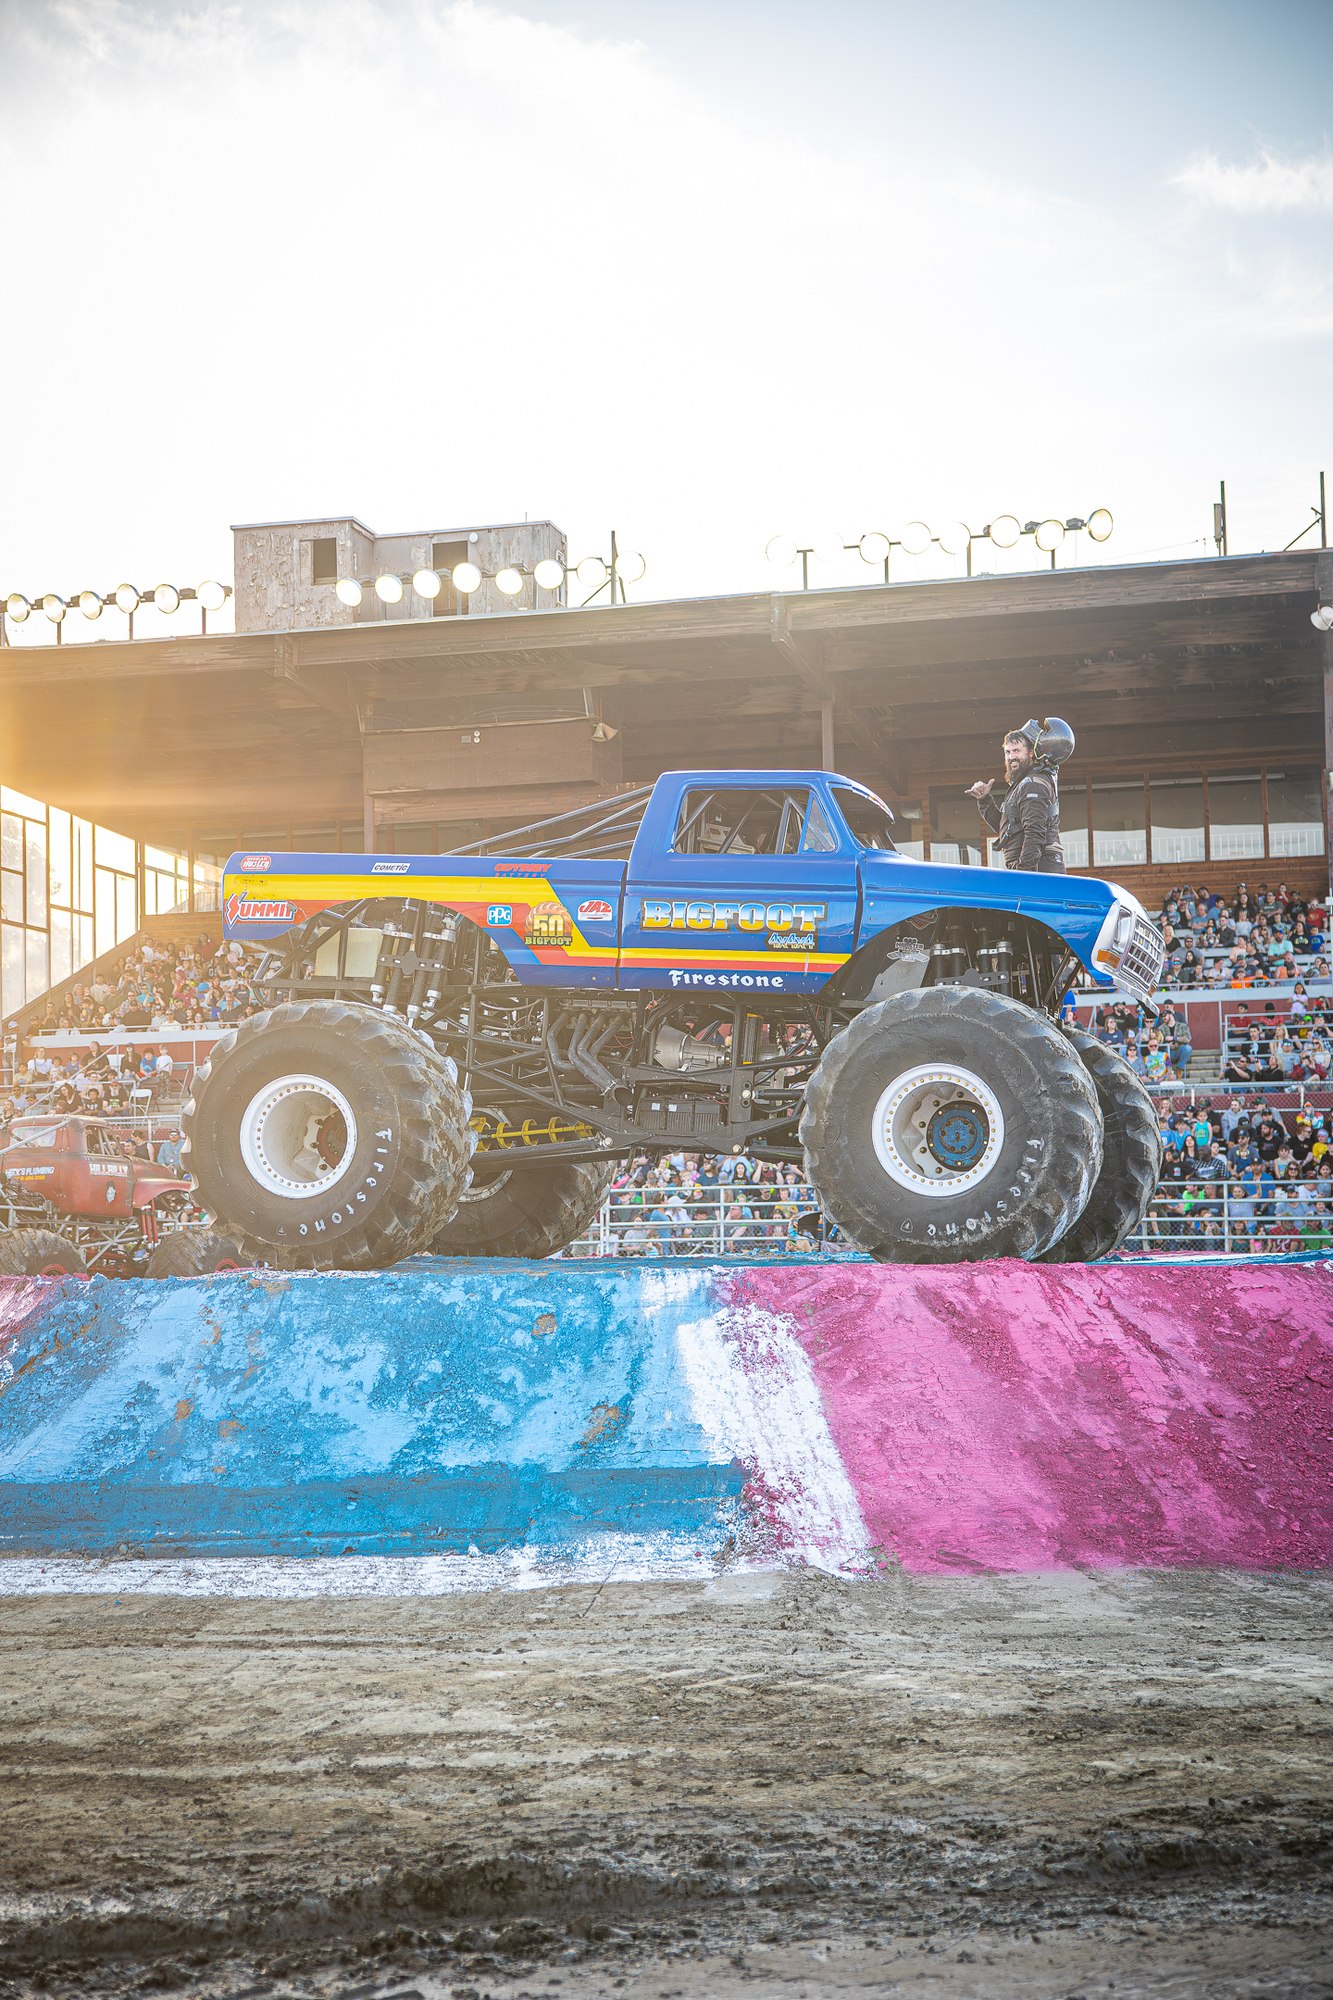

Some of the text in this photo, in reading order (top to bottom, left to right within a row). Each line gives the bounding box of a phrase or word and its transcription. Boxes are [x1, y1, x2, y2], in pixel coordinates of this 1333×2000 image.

[494, 863, 553, 872] ODYSSEY
[488, 907, 511, 924] PPG
[579, 901, 612, 913] JAZ
[642, 900, 826, 932] BIGFOOT
[532, 913, 565, 937] 50
[525, 936, 573, 946] BIGFOOT
[668, 969, 784, 988] Firestone
[299, 1127, 393, 1236] Firestone
